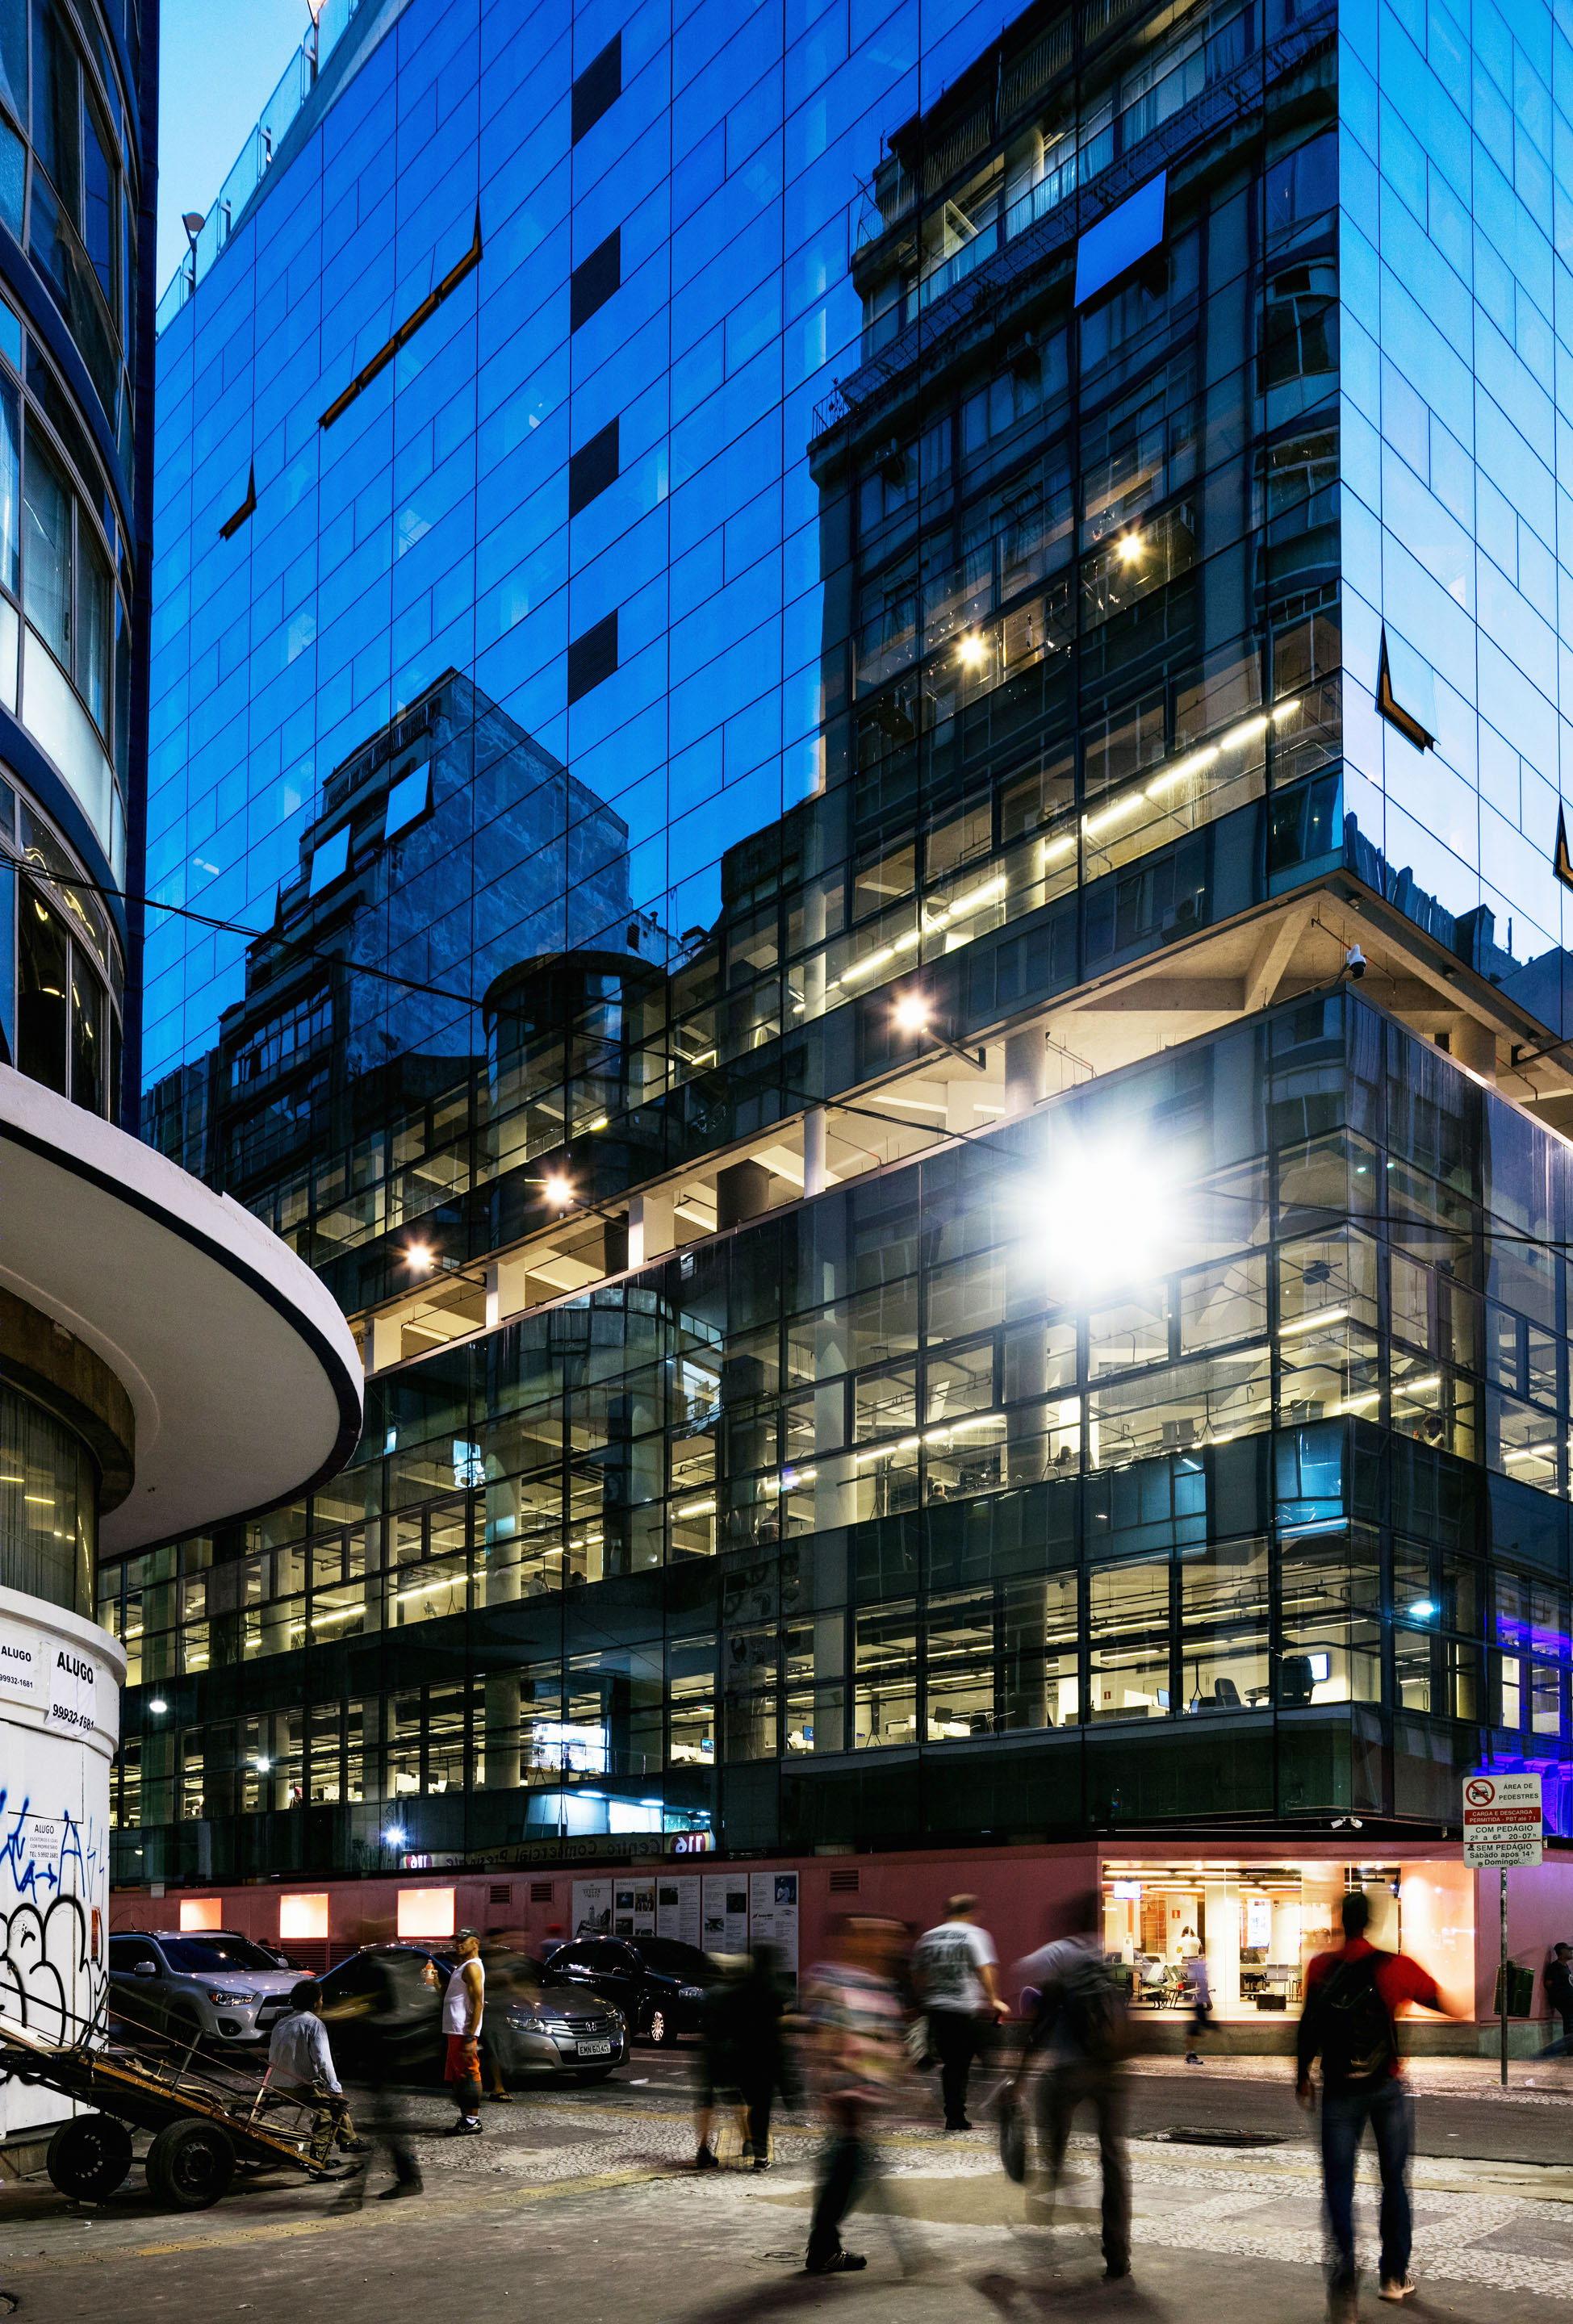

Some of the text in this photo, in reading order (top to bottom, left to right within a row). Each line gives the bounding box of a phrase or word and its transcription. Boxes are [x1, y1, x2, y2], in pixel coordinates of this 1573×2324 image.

[2, 1646, 31, 1662] ALUGO
[57, 1652, 94, 1684] ALUGO
[53, 1704, 94, 1730] 99932-1681
[35, 1825, 54, 1834] ALUGO
[1496, 1824, 1533, 1833] PEDÁGIO
[1496, 1842, 1532, 1850] PEDÁGIO
